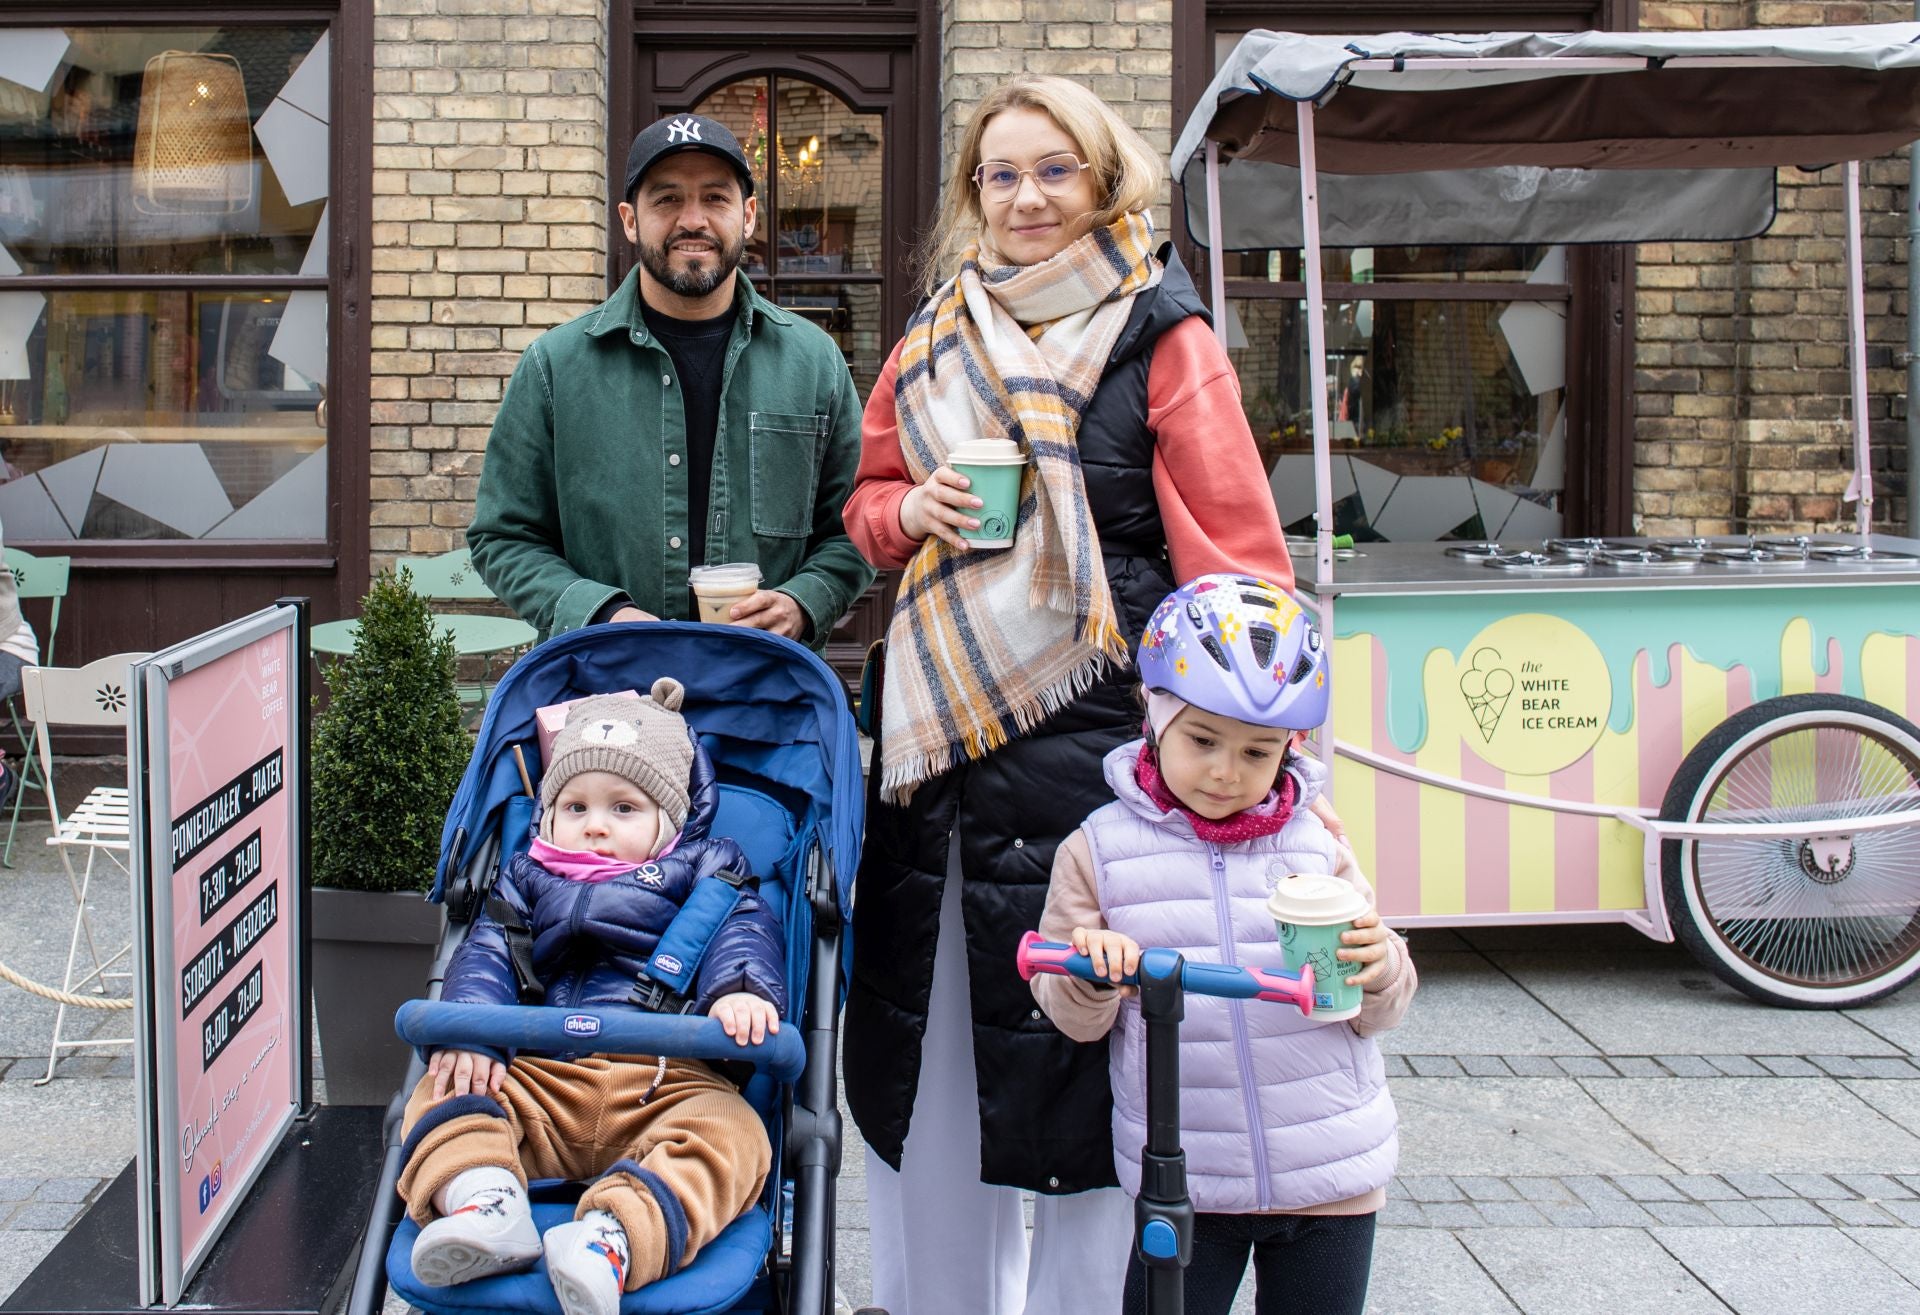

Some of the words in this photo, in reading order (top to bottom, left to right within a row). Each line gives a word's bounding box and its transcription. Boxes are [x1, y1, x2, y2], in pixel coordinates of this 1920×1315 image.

[667, 118, 702, 143] NY
[262, 657, 280, 679] WHITE
[1521, 661, 1543, 673] the
[262, 680, 278, 700] BEAR
[1521, 679, 1570, 691] WHITE
[262, 697, 284, 720] COFFEE
[1522, 698, 1561, 711] BEAR
[1522, 717, 1544, 730] ICE
[1548, 716, 1598, 729] CREAM
[172, 783, 241, 865] PONIEDZIAŁEK
[202, 865, 226, 914] 7:30
[235, 837, 260, 886] 21:00
[184, 940, 224, 1009] SOBOTA
[233, 888, 277, 958] NIEDZIELA
[205, 1006, 229, 1060] 8:00
[237, 969, 261, 1023] 21:00
[567, 1017, 597, 1031] chicco
